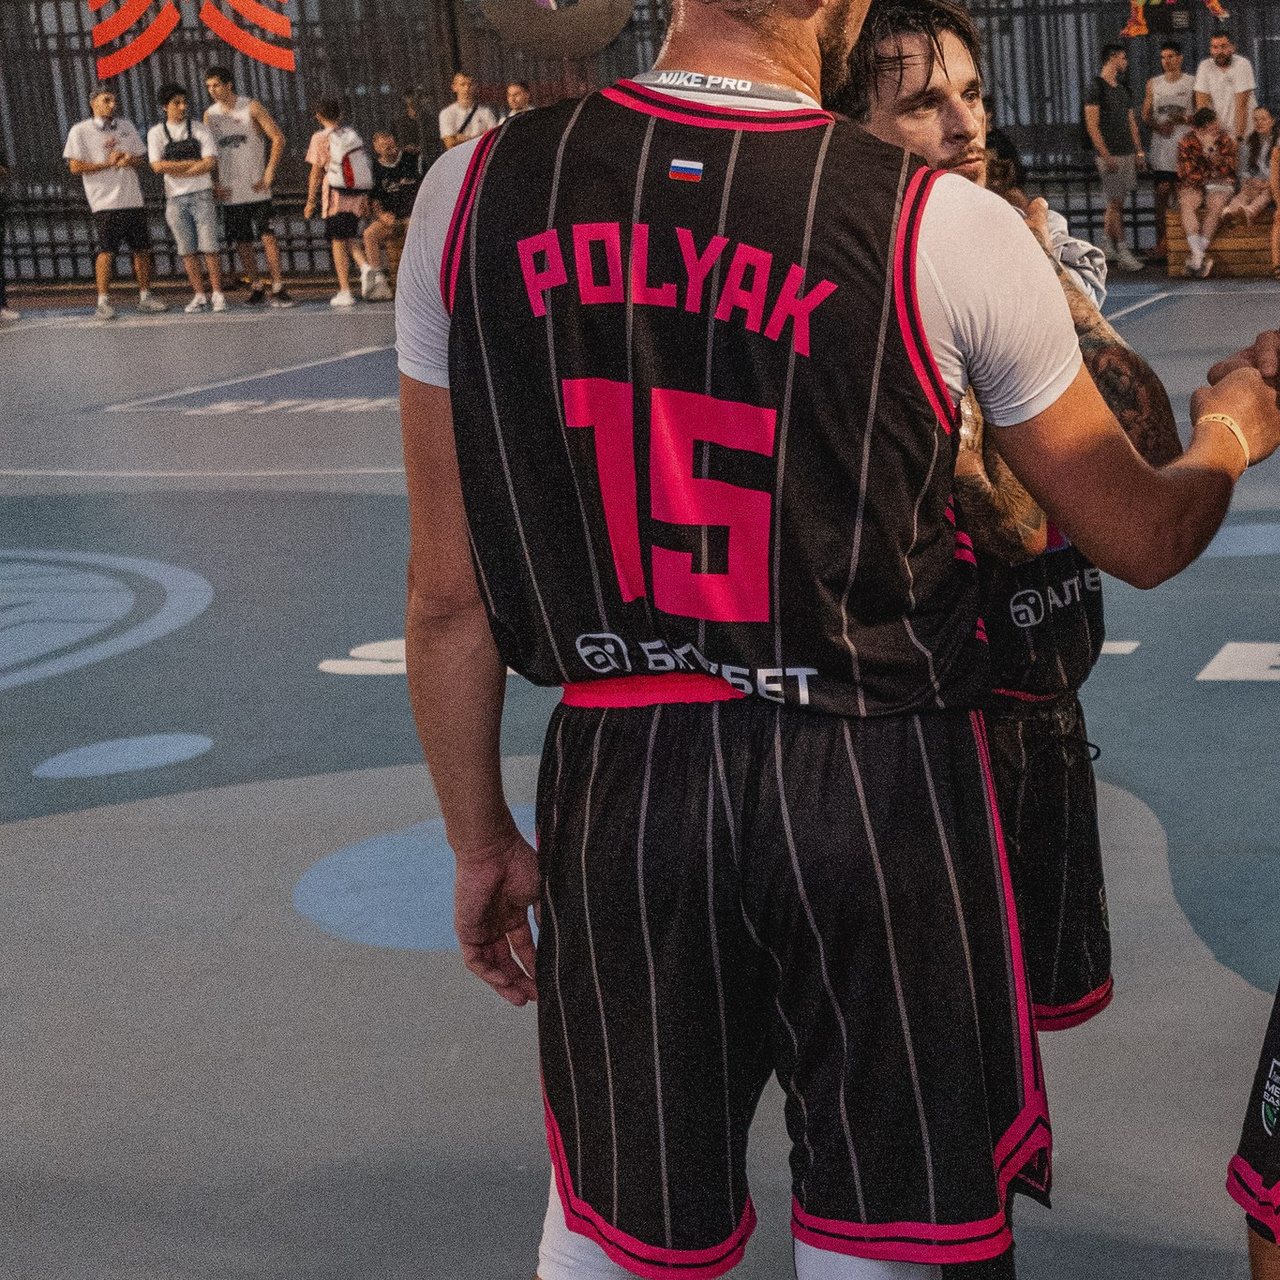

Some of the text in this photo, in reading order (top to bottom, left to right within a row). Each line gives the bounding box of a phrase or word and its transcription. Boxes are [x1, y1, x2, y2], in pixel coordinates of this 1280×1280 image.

[656, 72, 752, 92] NIKE PRO
[517, 222, 838, 357] POLYAK
[562, 378, 777, 622] 15
